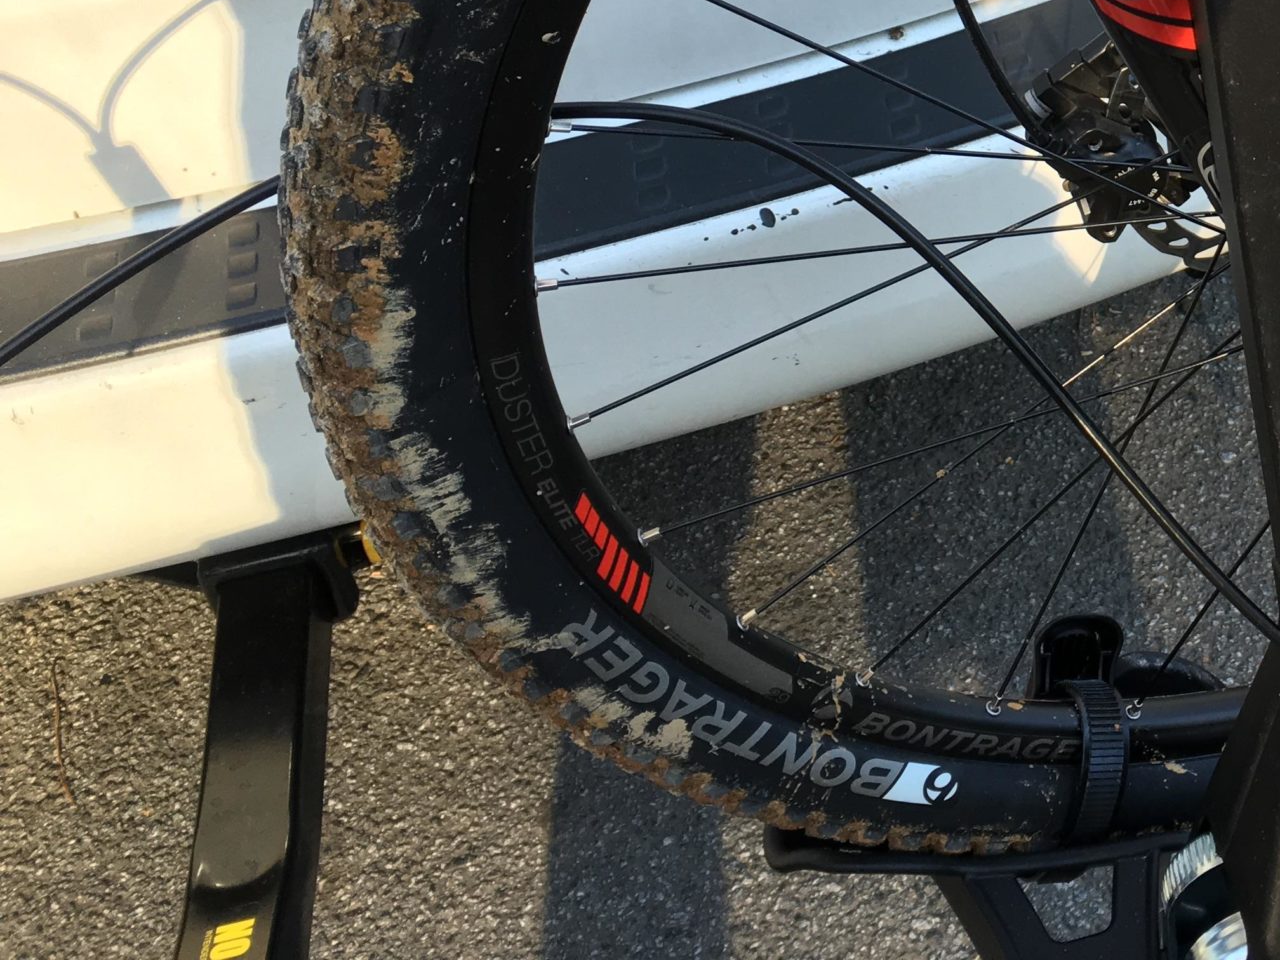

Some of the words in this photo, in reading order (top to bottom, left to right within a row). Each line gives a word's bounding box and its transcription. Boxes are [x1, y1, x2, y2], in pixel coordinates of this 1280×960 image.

[489, 351, 554, 476] DUSTER
[536, 478, 578, 531] ELITE
[560, 607, 905, 799] BONTRAGER
[852, 711, 1082, 760] BONTRAGE
